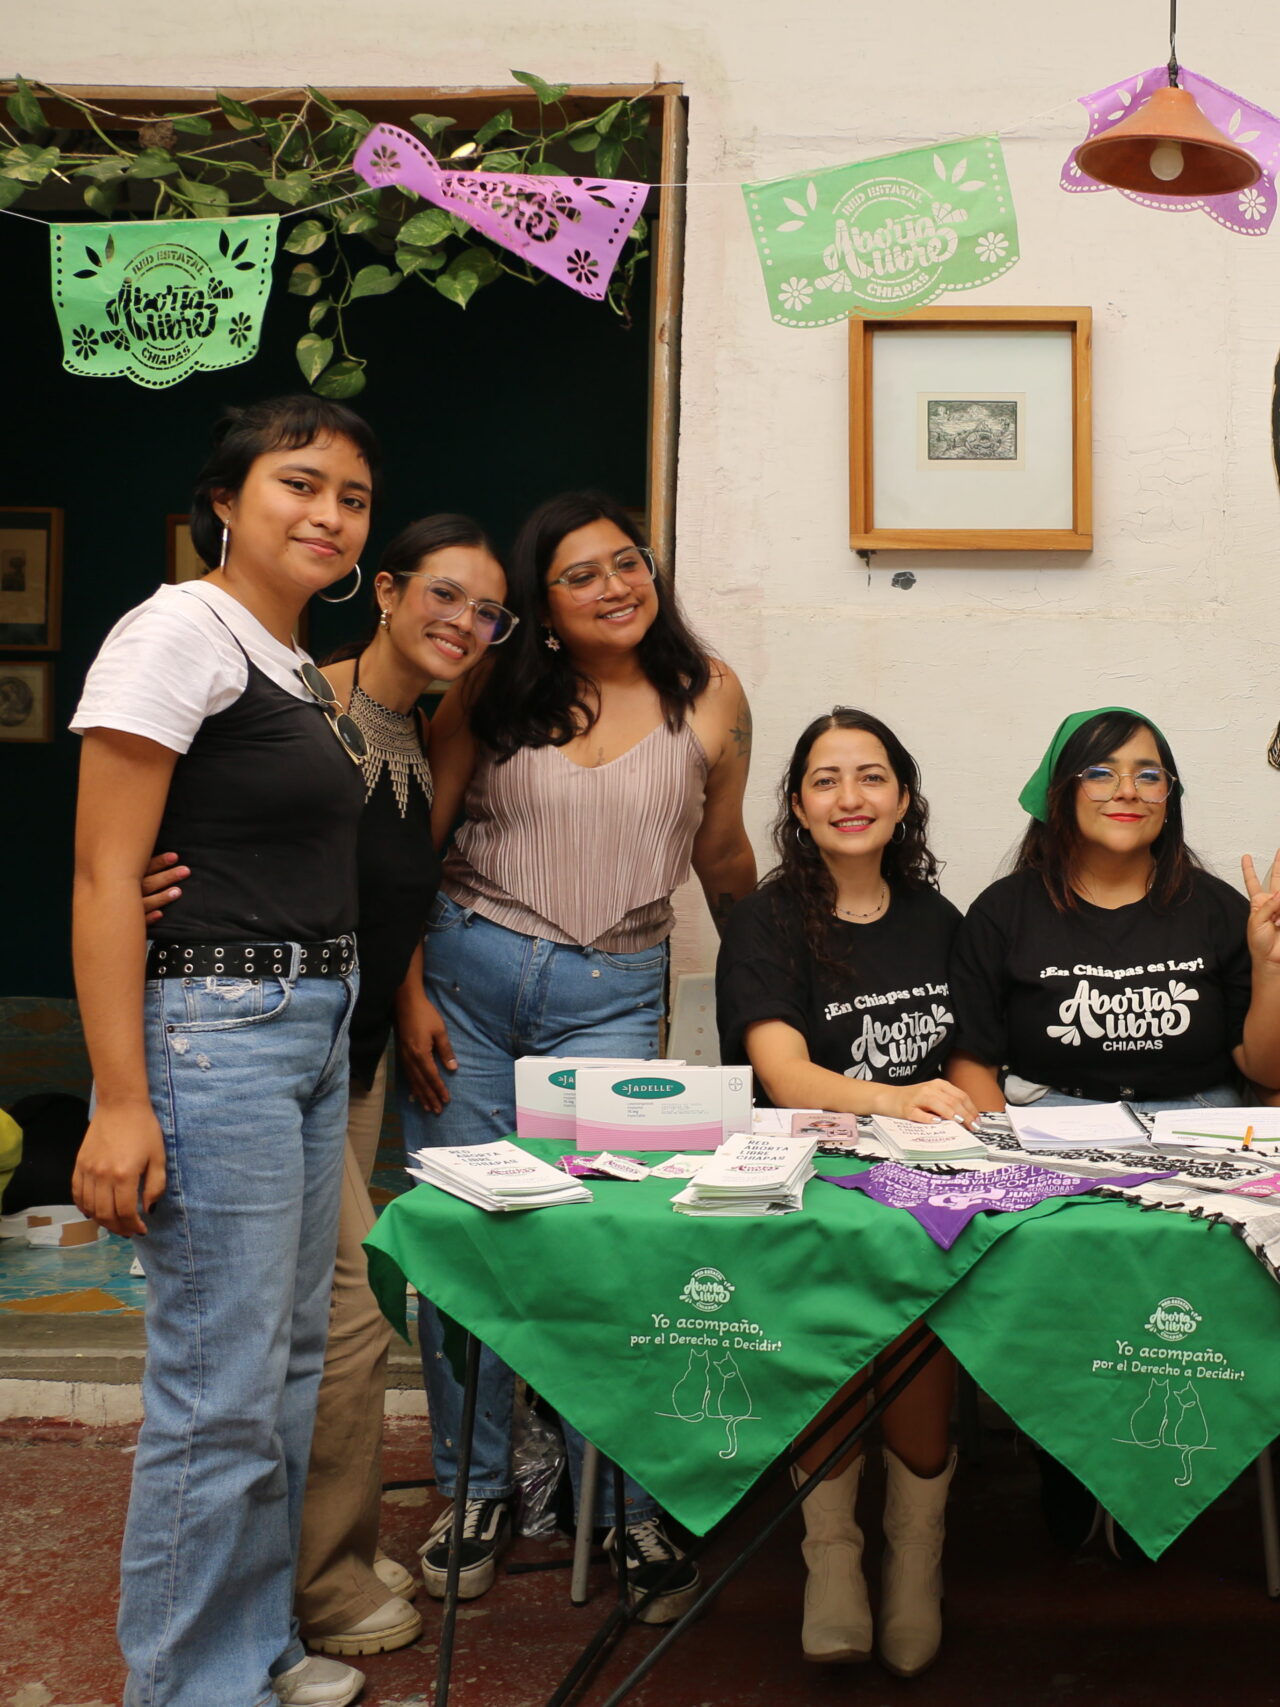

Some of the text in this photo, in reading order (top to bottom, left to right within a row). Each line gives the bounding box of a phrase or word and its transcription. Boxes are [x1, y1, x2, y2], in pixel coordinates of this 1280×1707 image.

[867, 184, 922, 203] ESTATAL
[157, 250, 205, 275] ESTATAL
[867, 273, 930, 298] CHIAPAS
[141, 345, 190, 365] CHIAPAS
[1040, 957, 1205, 980] ¡En Chiapas es Ley!
[824, 982, 949, 1020] ¡En Chiapas es Ley!
[1059, 980, 1171, 1039] Aborta
[1106, 1003, 1190, 1039] libre
[851, 1011, 936, 1068] Aborta
[1102, 1039, 1163, 1051] CHIAPAS
[888, 1065, 917, 1077] CHIAP
[626, 1084, 671, 1095] JADELLE
[972, 1171, 1027, 1185] VALIENTES
[684, 1277, 724, 1300] Aborta
[652, 1313, 764, 1336] Yo acompaño,
[1149, 1307, 1190, 1330] Aborta
[630, 1333, 782, 1352] por el Derecho a Decidir!
[1116, 1339, 1228, 1366] Yo acompaño,
[1092, 1359, 1245, 1381] por el Derecho a Decidir!
